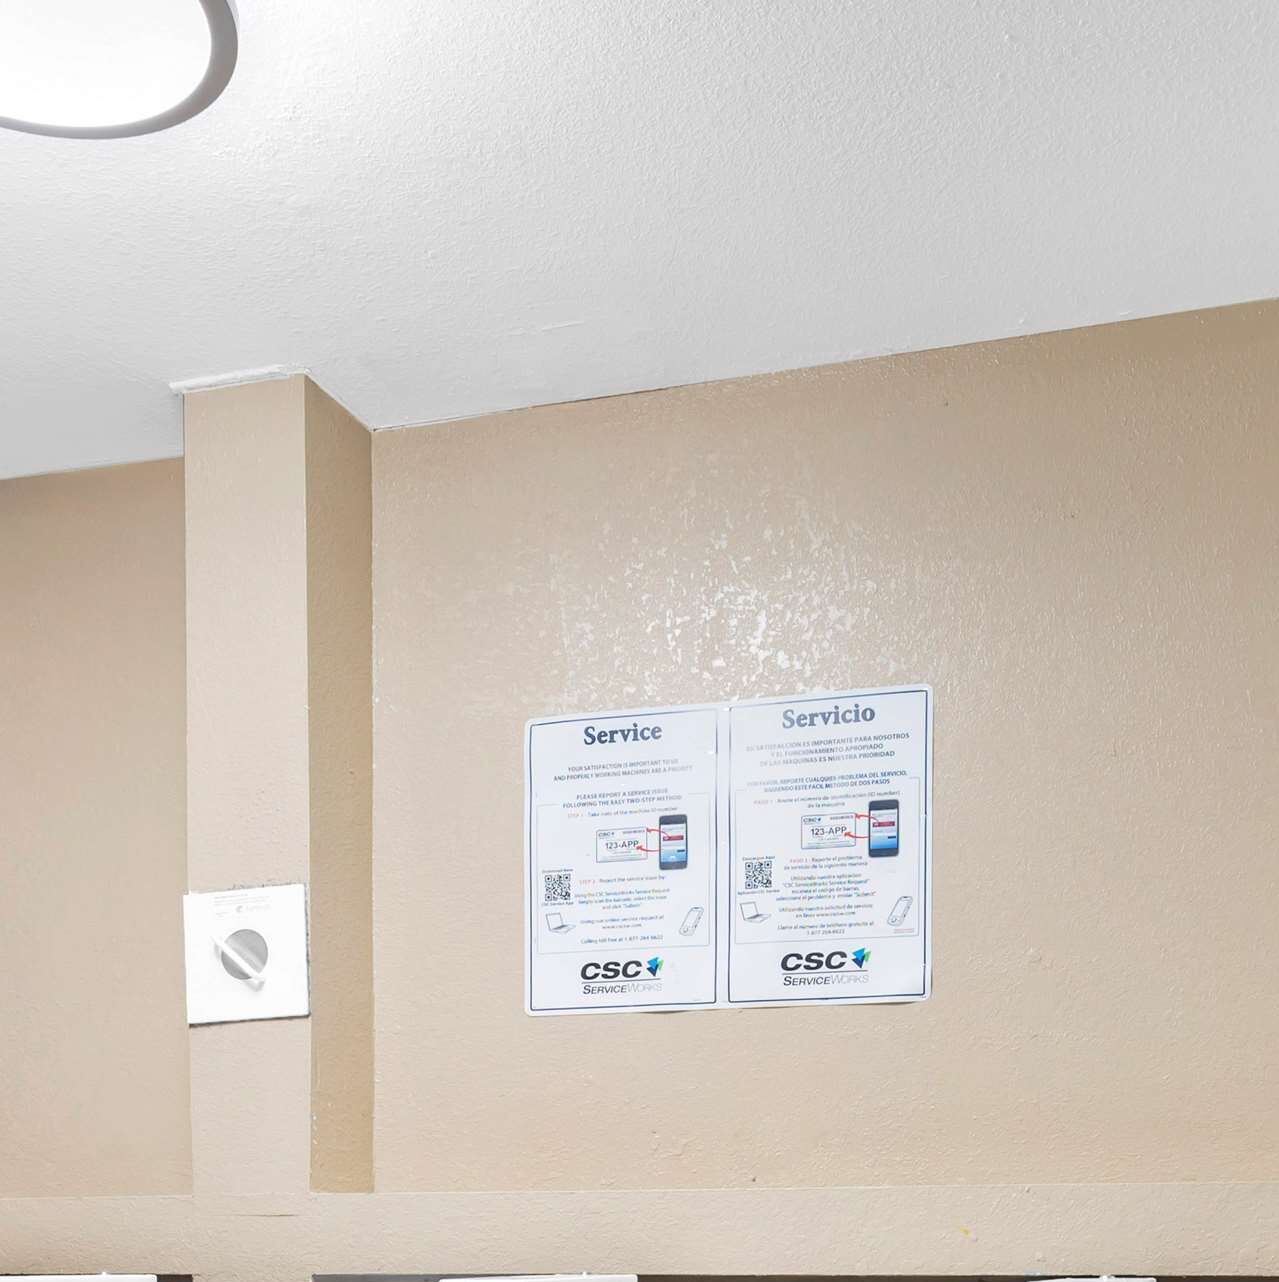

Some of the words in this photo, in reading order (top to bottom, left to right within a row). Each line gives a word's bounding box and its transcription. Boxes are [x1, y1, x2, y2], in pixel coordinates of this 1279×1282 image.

[782, 703, 875, 729] Servicio
[584, 723, 662, 745] Service
[811, 737, 853, 746] IMPORTANTE
[854, 735, 872, 743] PARA
[873, 732, 910, 741] NOSOTROS
[845, 743, 884, 752] APROPIADO
[859, 751, 895, 759] PRIORIDAD
[563, 800, 597, 808] FOLLOWING
[810, 826, 847, 836] 123-APP
[605, 840, 639, 850] 123-APP
[781, 950, 847, 971] CSC
[580, 960, 642, 980] CSC
